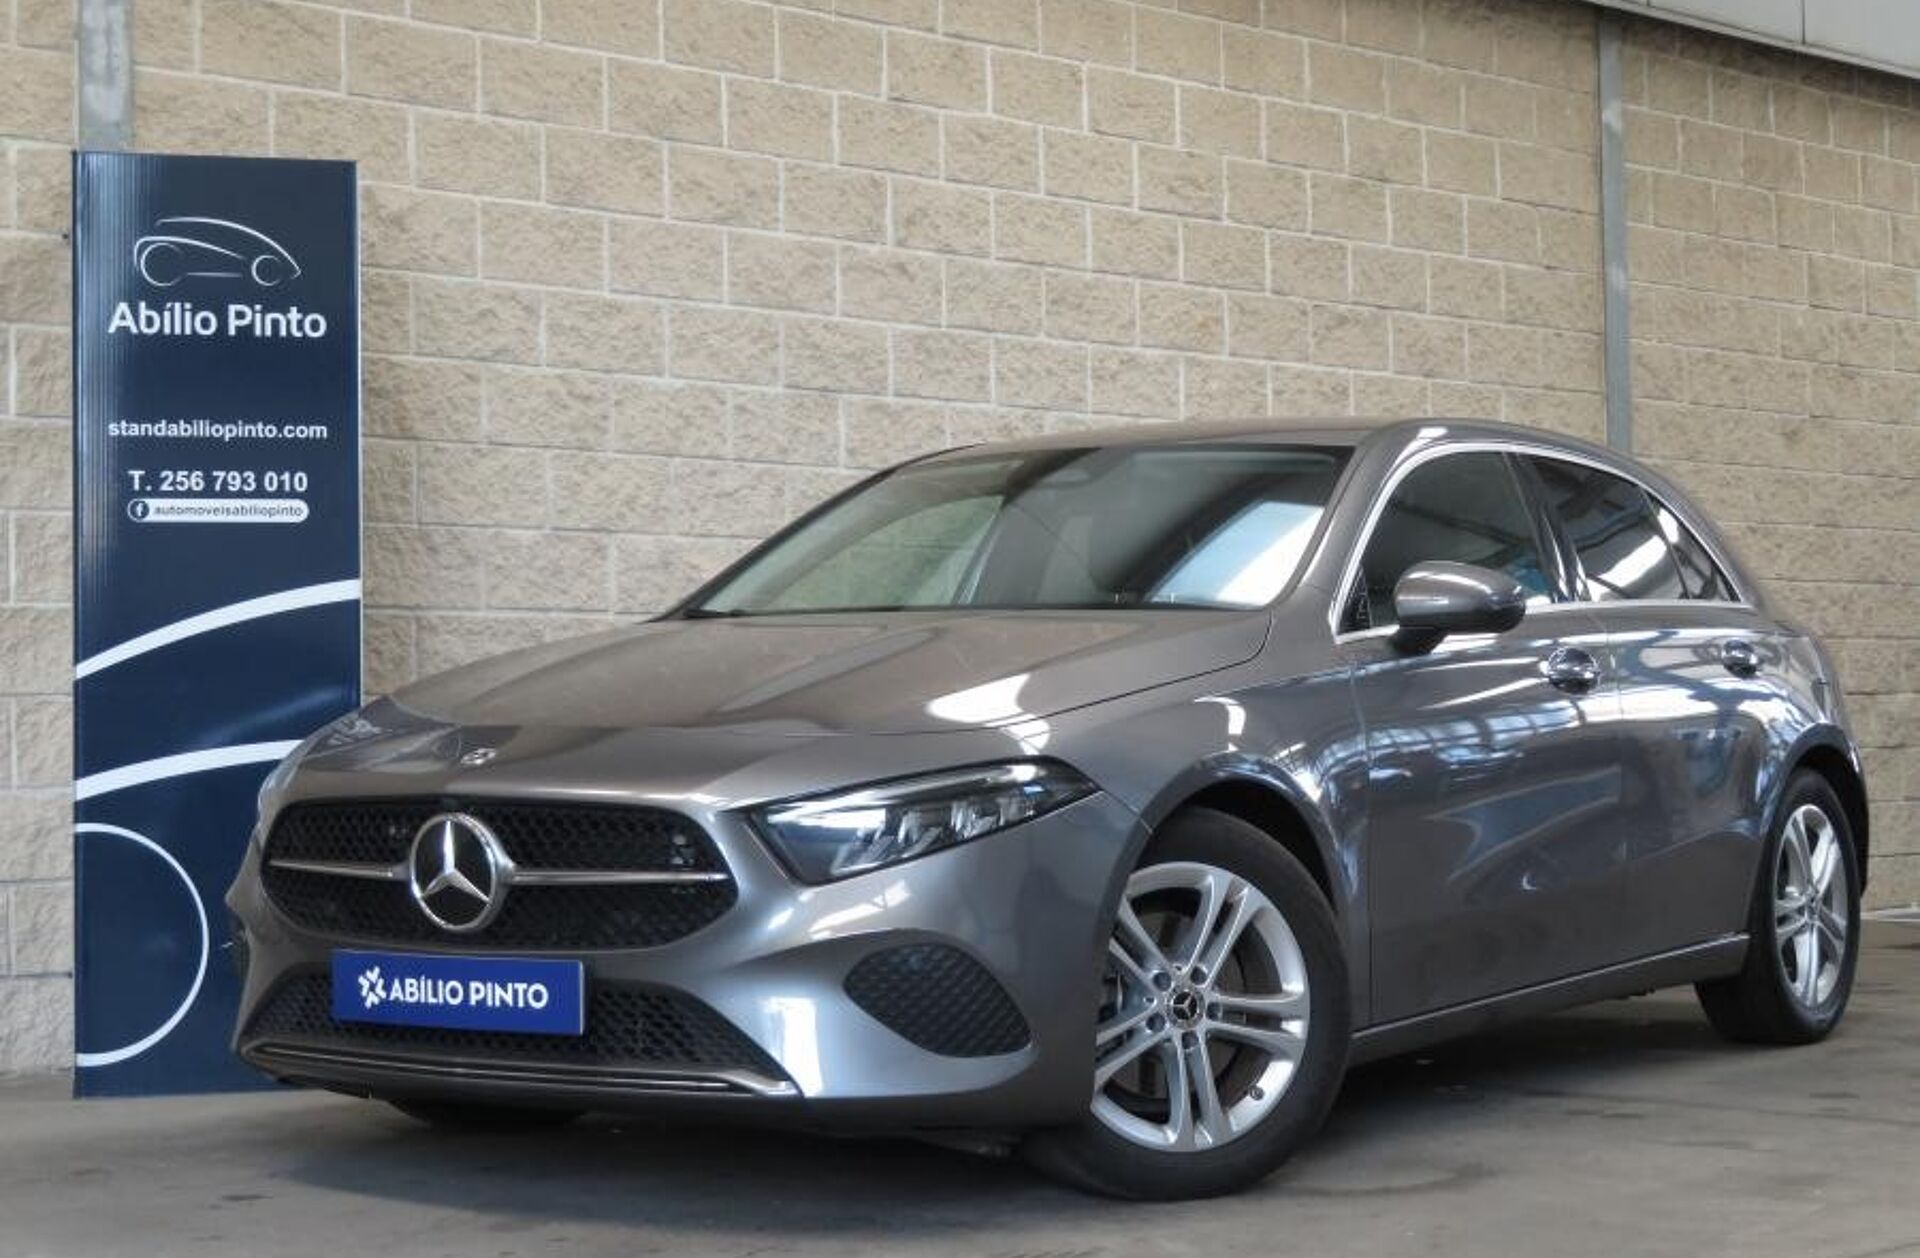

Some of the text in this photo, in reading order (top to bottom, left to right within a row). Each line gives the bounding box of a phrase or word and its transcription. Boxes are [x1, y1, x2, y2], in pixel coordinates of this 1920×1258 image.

[107, 300, 328, 338] Abílio Pinto
[107, 419, 328, 441] standabiliopinto.com
[128, 470, 308, 492] T. 256 793 010
[153, 504, 304, 518] automoveisabiliopinto
[389, 975, 549, 1010] ABÍLIO PINTO
